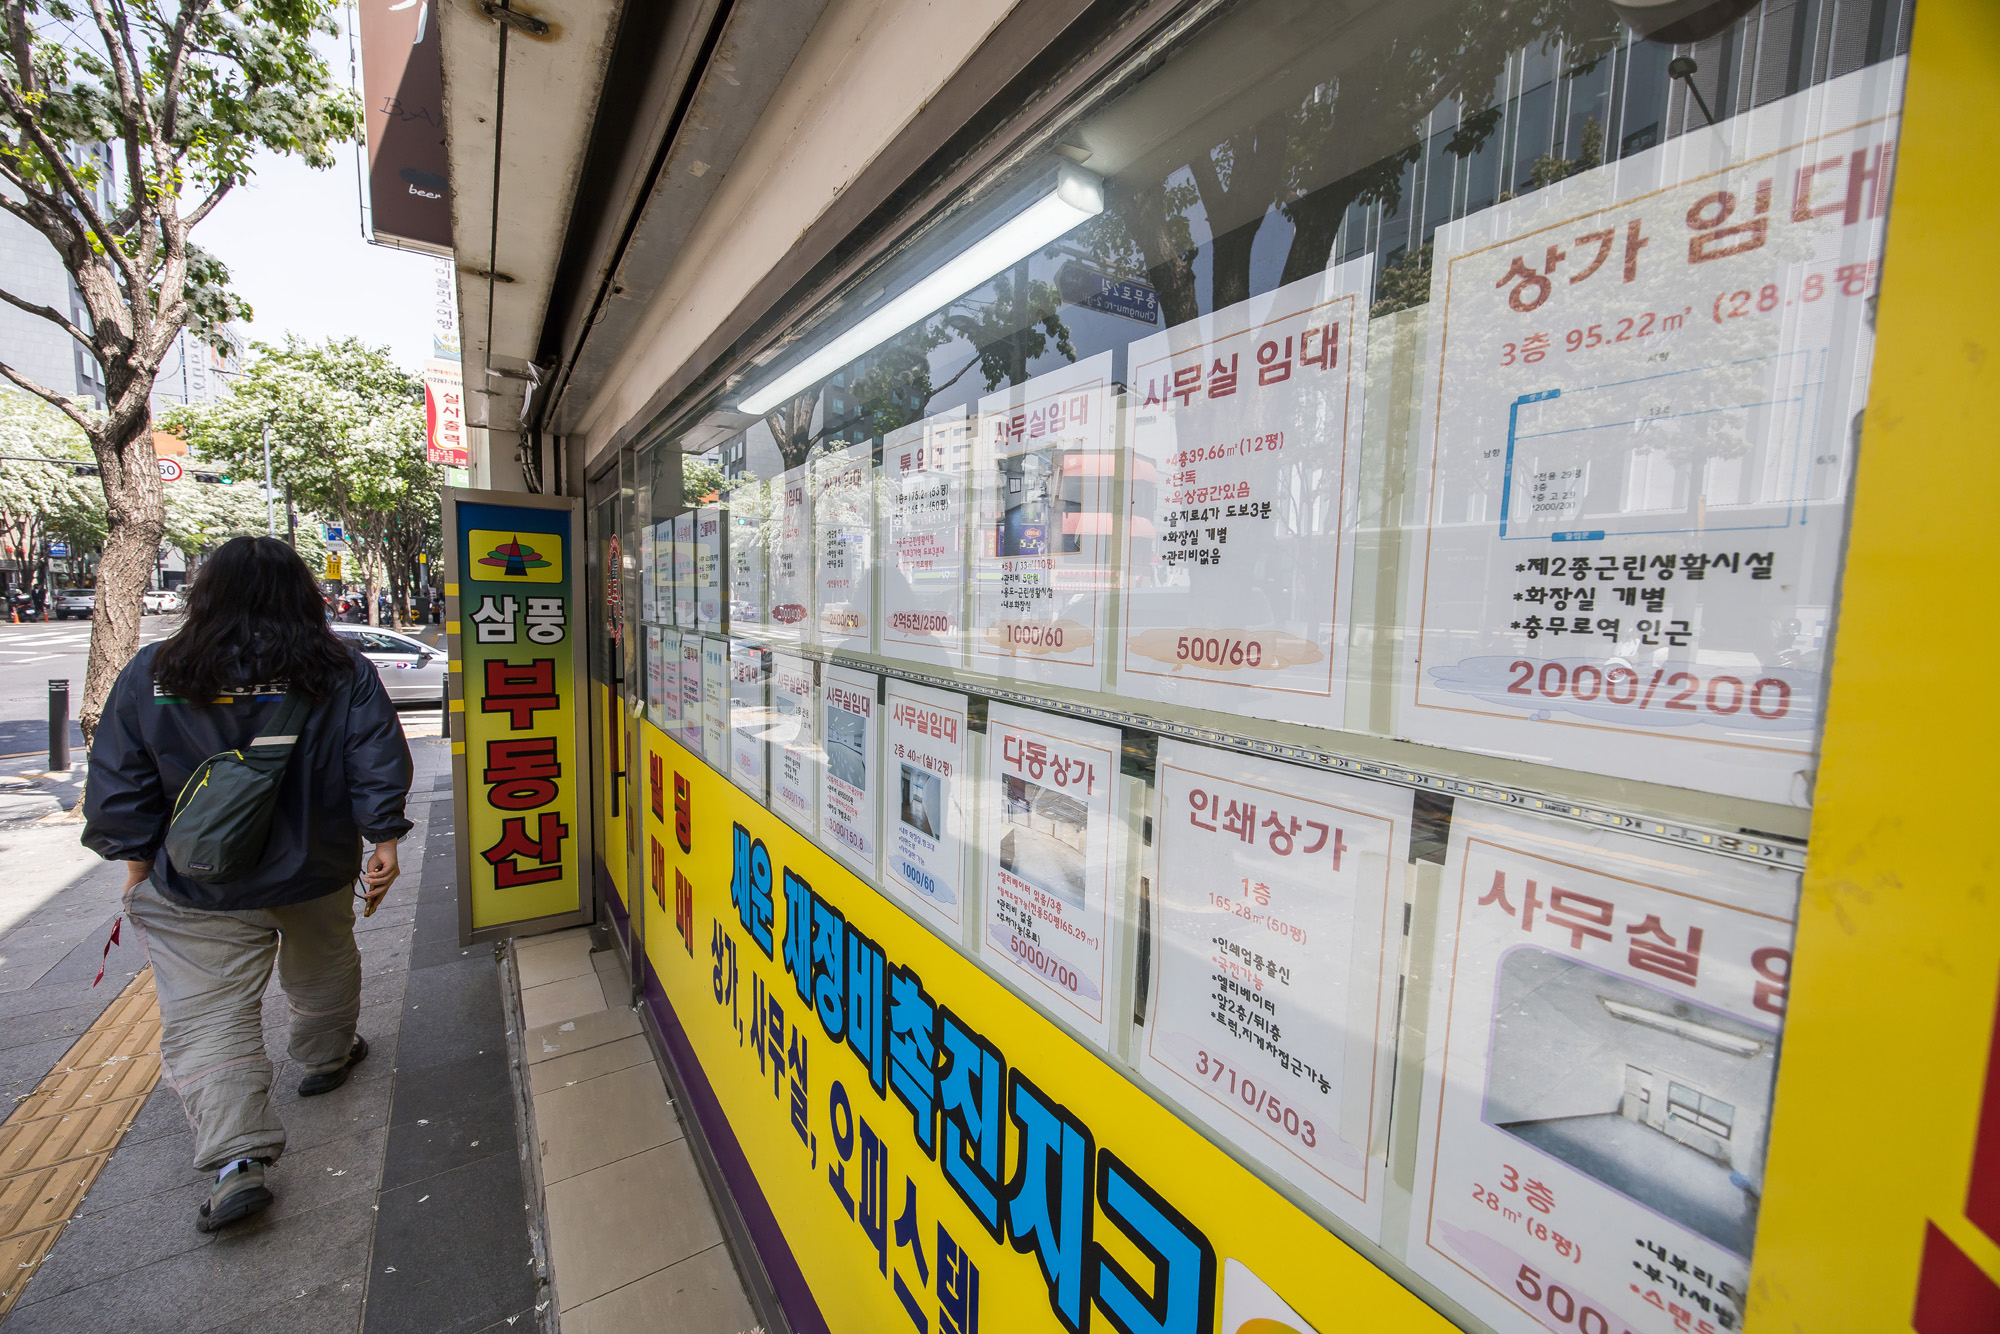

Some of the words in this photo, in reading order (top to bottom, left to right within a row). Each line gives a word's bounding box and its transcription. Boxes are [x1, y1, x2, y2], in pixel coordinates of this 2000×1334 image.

[408, 184, 441, 199] beer
[1496, 218, 1649, 313] 상가
[1685, 138, 1894, 265] 임대
[1142, 352, 1239, 412] 사무실
[1256, 321, 1340, 387] 임대
[1500, 332, 1551, 368] 3층
[443, 393, 460, 446] 실사출력
[994, 393, 1088, 446] 사무실임대
[159, 464, 176, 476] 50
[1172, 469, 1197, 488] 단독
[1171, 480, 1250, 506] 옥상공간있음
[1168, 506, 1220, 528] 을지로4가
[1225, 501, 1272, 520] 도보3분
[1167, 529, 1199, 547] 화장실
[1205, 526, 1228, 543] 개별
[1166, 547, 1221, 566] 관리비없음
[1526, 552, 1775, 580] 제2종근린생활시설
[1524, 587, 1596, 612] 화장실
[1613, 587, 1667, 613] 개별
[469, 594, 567, 645] 삼풍
[893, 613, 948, 632] 2억5천/2500
[1007, 624, 1063, 648] 1000/60
[1522, 615, 1620, 643] 충무로역
[1637, 619, 1693, 647] 인근
[1176, 636, 1262, 667] 500/60
[732, 660, 759, 685] 건물매매
[777, 671, 810, 699] 사무실임대
[1507, 660, 1792, 720] 2000/200
[826, 686, 871, 718] 사무실임대
[893, 702, 957, 744] 사무실임대
[894, 743, 905, 759] 2층
[1003, 735, 1095, 796] 다동상가
[480, 658, 569, 890] 부동산
[650, 749, 692, 855] 빌딩
[1544, 803, 1571, 815] SAMSUNG
[829, 818, 864, 851] 3000/150.8
[1188, 788, 1348, 873] 인쇄상가
[730, 820, 774, 963] 세운
[902, 861, 935, 894] 1000/60
[1000, 871, 1031, 895] 엘리베이터
[1033, 889, 1063, 915] 있음/3층
[1241, 877, 1272, 907] 1층
[651, 833, 694, 960] 매매
[999, 898, 1017, 917] 관리비
[1020, 911, 1033, 928] 없음
[999, 912, 1041, 947] 주차가능(유료)
[1478, 869, 1704, 987] 사무실
[1010, 934, 1078, 992] 5000/700
[1217, 937, 1291, 986] 인쇄업종출신
[1217, 957, 1265, 992] 국전가능
[1217, 974, 1276, 1016] 엘리베이터
[1195, 1050, 1317, 1148] 3710/503
[710, 917, 744, 1049] 상가,
[749, 970, 817, 1171] 사무실,
[828, 1080, 980, 1334] 오피스텔
[1500, 1164, 1556, 1215] 3층
[1515, 1263, 1632, 1334] 500
